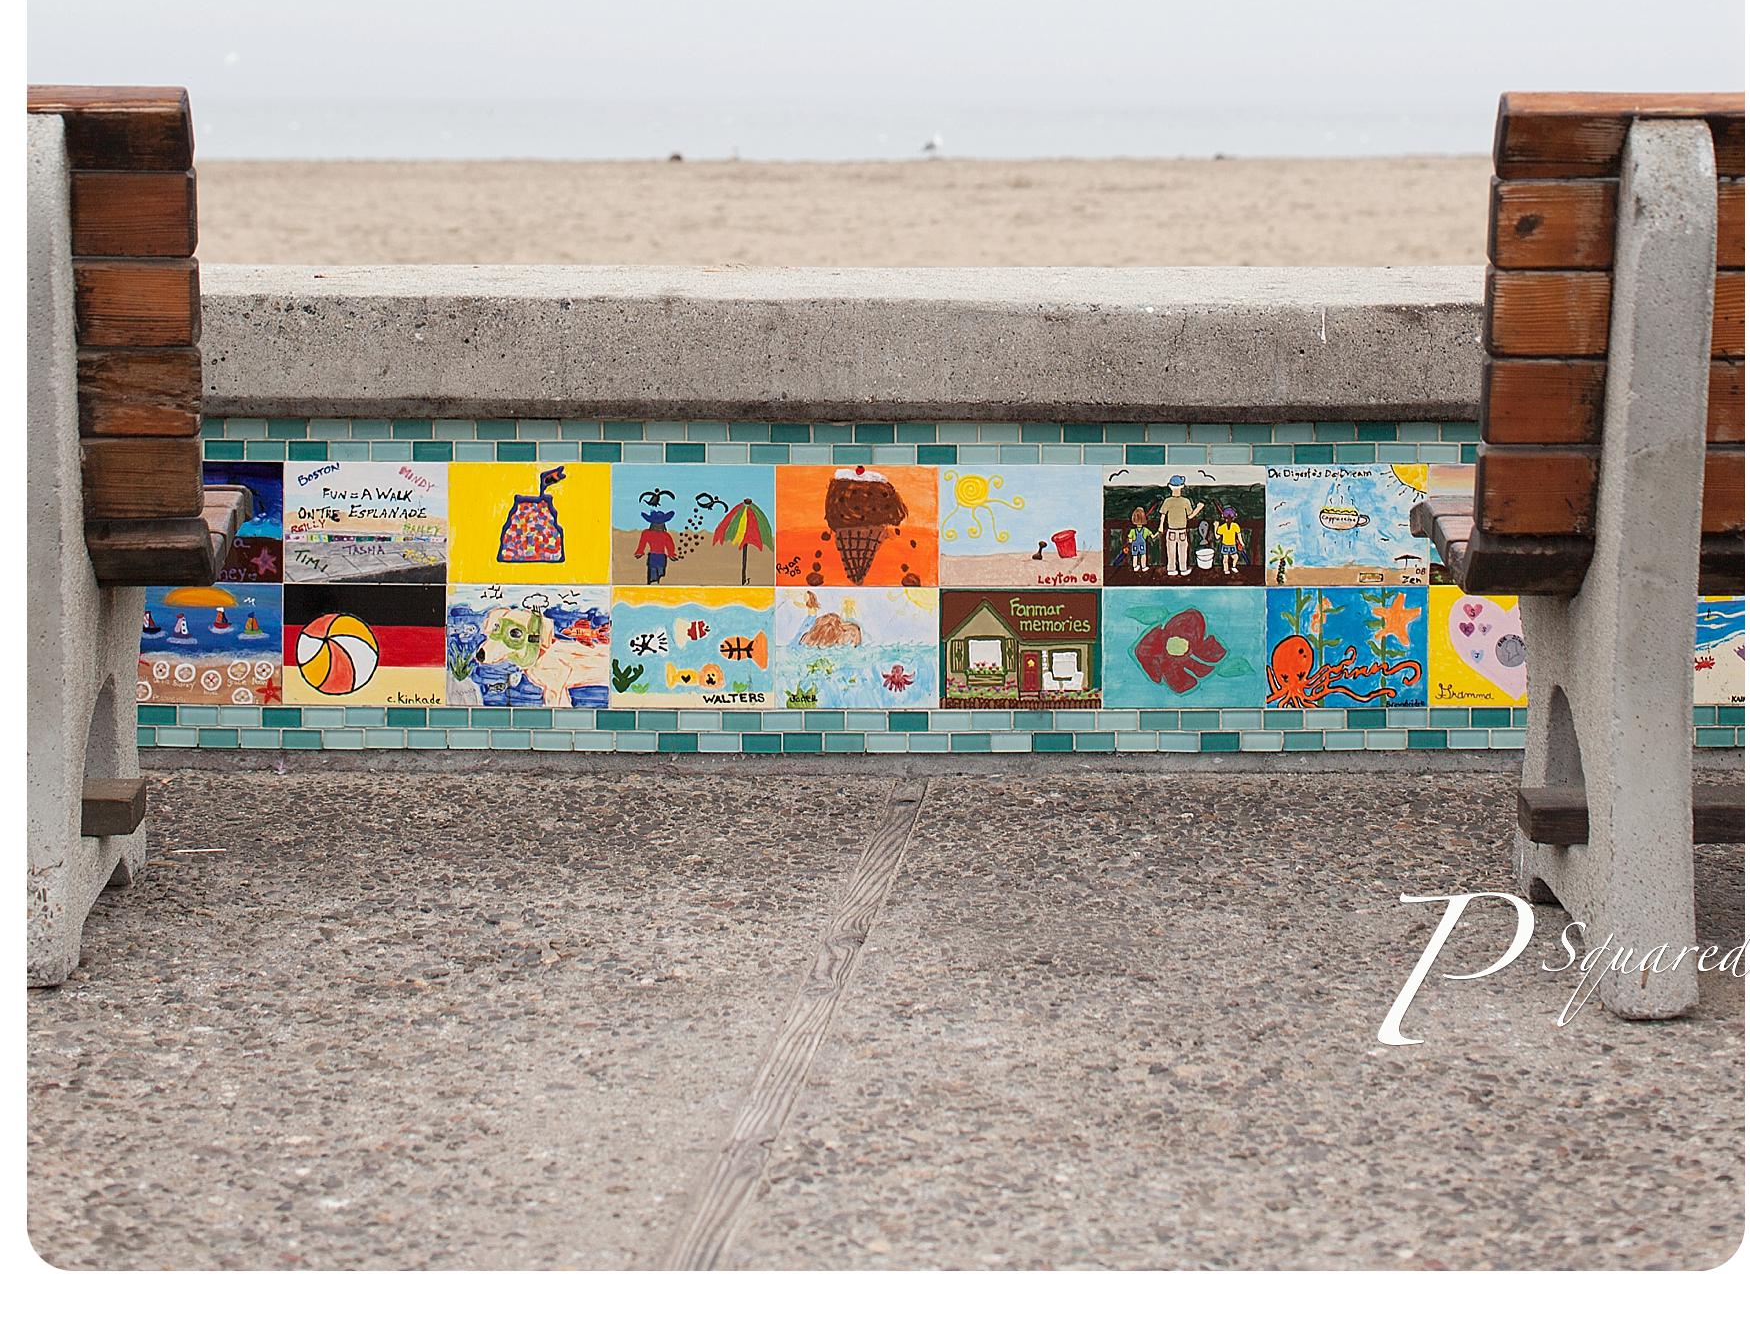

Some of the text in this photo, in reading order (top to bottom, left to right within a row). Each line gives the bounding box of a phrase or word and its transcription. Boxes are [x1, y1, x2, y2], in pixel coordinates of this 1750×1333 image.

[298, 463, 340, 486] BOSTON
[399, 466, 435, 492] MINDY
[322, 488, 347, 500] FUN
[361, 488, 373, 500] A
[376, 488, 413, 502] WALK
[298, 507, 315, 519] ON
[348, 504, 427, 519] ESPLANADE
[776, 556, 801, 574] Ryan
[790, 566, 801, 577] 08
[1038, 572, 1097, 586] Leyton 08
[1009, 597, 1065, 616] Fanmar
[1020, 615, 1091, 633] memories
[703, 693, 765, 704] WALTERS
[1435, 683, 1495, 700] Gramma
